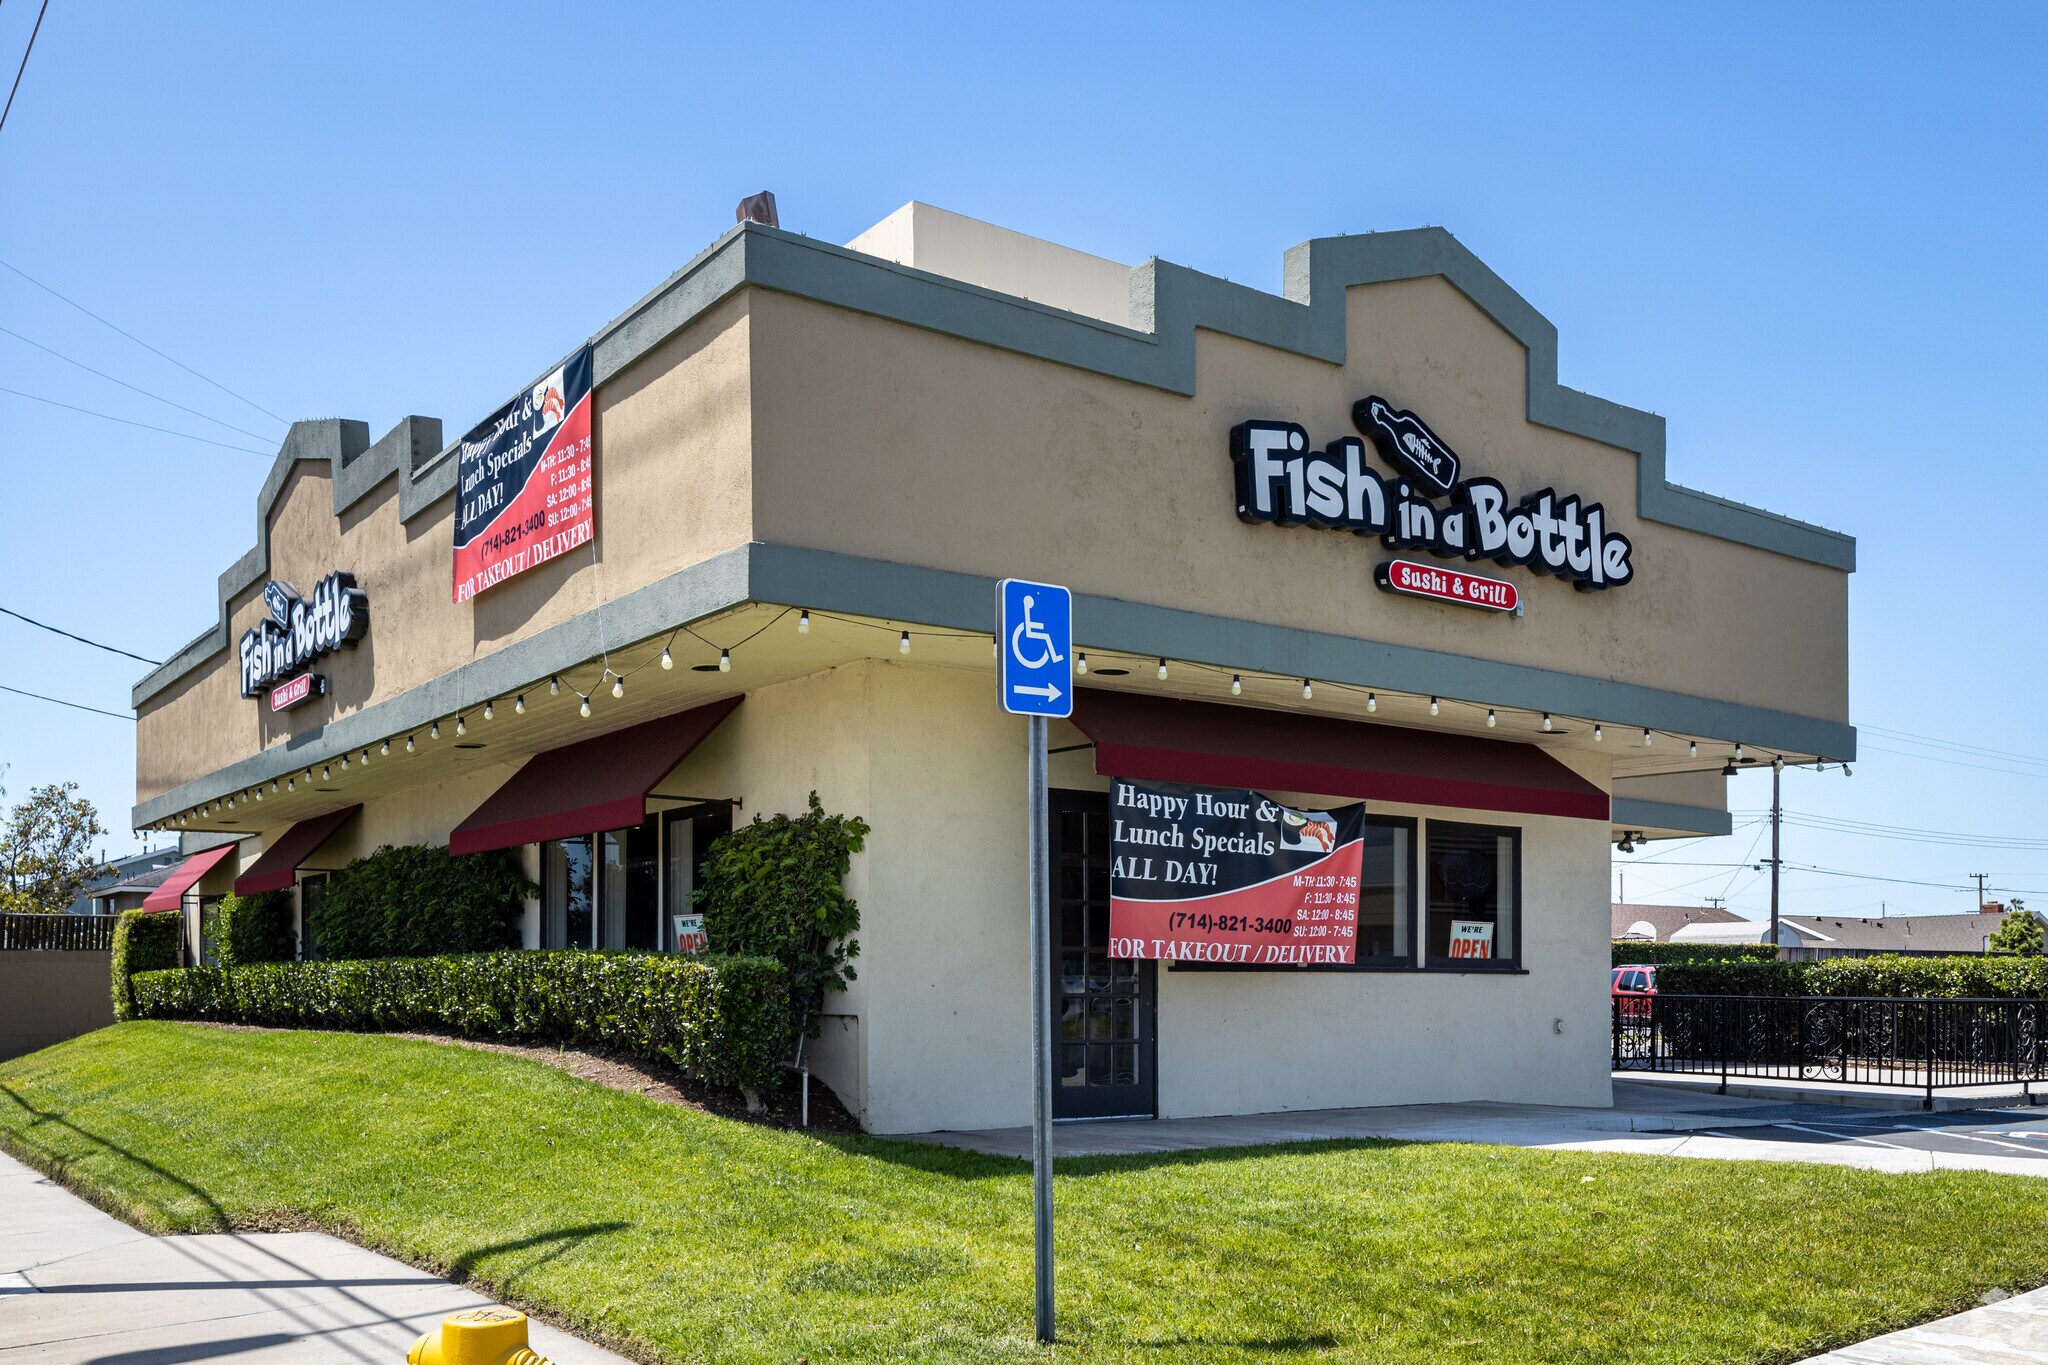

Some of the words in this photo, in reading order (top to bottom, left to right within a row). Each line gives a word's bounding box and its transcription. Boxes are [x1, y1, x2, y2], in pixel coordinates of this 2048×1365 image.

[461, 433, 494, 464] Happy
[522, 397, 532, 420] &
[461, 459, 485, 497] Lunch
[487, 431, 532, 480] Specials
[557, 444, 575, 464] 11:30
[550, 473, 558, 486] F:
[558, 464, 576, 483] 11:30
[461, 500, 477, 530] ALL
[478, 482, 503, 516] DAY!
[546, 493, 558, 508] SA:
[559, 484, 577, 503] 12:00
[1249, 428, 1386, 526] Fish
[1397, 484, 1434, 540] in
[1442, 512, 1464, 548] a
[1469, 484, 1630, 583] Bottle
[548, 512, 558, 527] SU:
[560, 503, 578, 522] 12:00
[481, 510, 545, 561] (714)-821-3400
[457, 578, 476, 603] FOR
[476, 551, 525, 593] TAKEOUT
[526, 546, 531, 569] /
[533, 518, 592, 565] DELIVERY
[1401, 567, 1447, 593] Sushi
[1452, 577, 1464, 595] &
[1469, 581, 1507, 604] Grill
[240, 620, 272, 694] Fish
[273, 635, 284, 674] in
[285, 634, 293, 664] a
[292, 576, 350, 657] Bottle
[274, 688, 288, 707] Sushi
[289, 685, 293, 699] &
[293, 678, 306, 697] Grill
[1117, 784, 1189, 820] Happy
[1196, 794, 1249, 819] Hour
[1256, 800, 1279, 822] &
[1114, 820, 1184, 848] Lunch
[1191, 828, 1275, 858] Specials
[1111, 856, 1157, 881] ALL
[1165, 860, 1218, 886] DAY!
[1315, 876, 1335, 887] 11:30
[1339, 876, 1357, 887] 7:45
[1304, 892, 1312, 903] F:
[1314, 892, 1333, 904] 11:30
[1336, 892, 1356, 904] 8:45
[681, 919, 698, 927] WE'RE
[1169, 911, 1292, 934] (714)-821-3400
[1297, 909, 1310, 920] SA:
[1311, 909, 1330, 920] 12:00
[1334, 909, 1355, 920] 8:45
[1293, 926, 1307, 937] SU:
[1309, 926, 1327, 937] 12:00
[1333, 926, 1354, 937] 7:45
[1110, 937, 1146, 959] FOR
[1151, 939, 1251, 963] TAKEOUT
[1252, 944, 1262, 963] /
[1264, 944, 1350, 964] DELIVERY
[1451, 937, 1490, 958] OPEN
